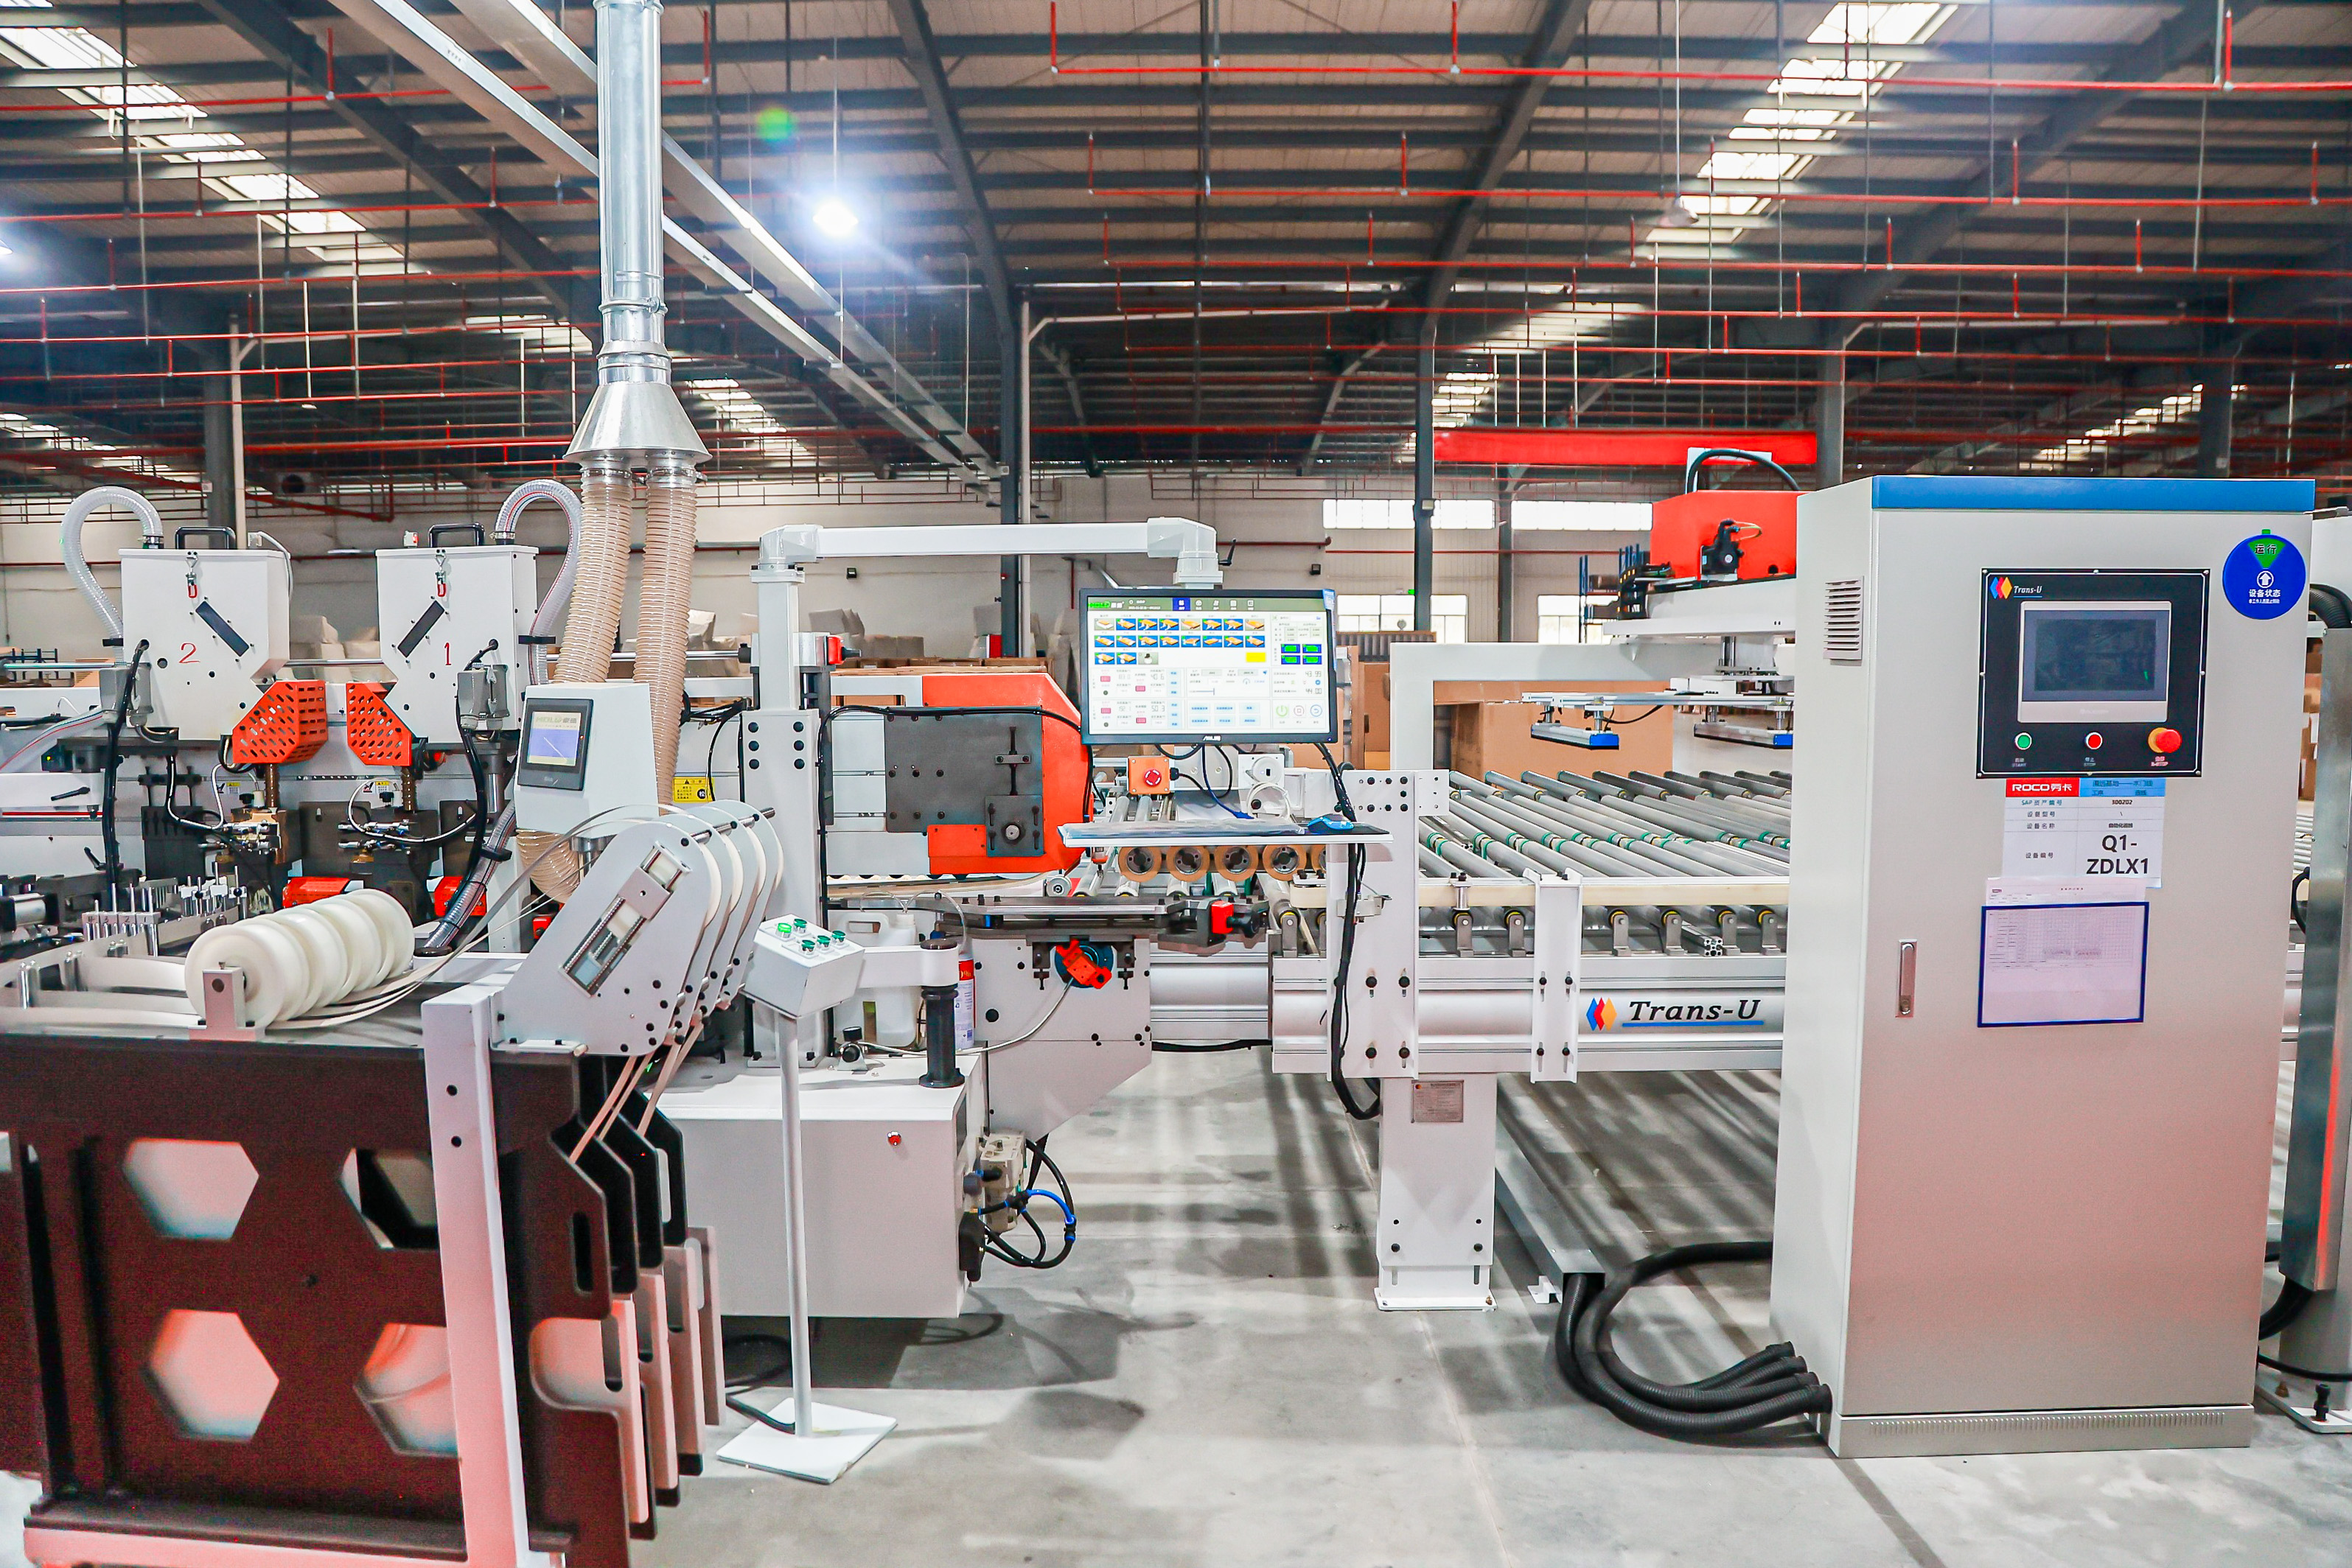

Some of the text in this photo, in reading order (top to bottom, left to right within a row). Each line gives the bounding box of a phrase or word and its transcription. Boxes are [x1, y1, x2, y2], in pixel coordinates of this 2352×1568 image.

[2255, 544, 2277, 555] 运行
[2013, 585, 2042, 594] Trans-U
[2249, 589, 2281, 598] 设备状态
[178, 643, 200, 664] 2
[444, 643, 452, 665] 1
[2011, 783, 2050, 791] ROCO
[2101, 834, 2138, 853] Q1-
[2086, 858, 2149, 875] ZDLX1
[1628, 998, 1762, 1021] Trans-U
